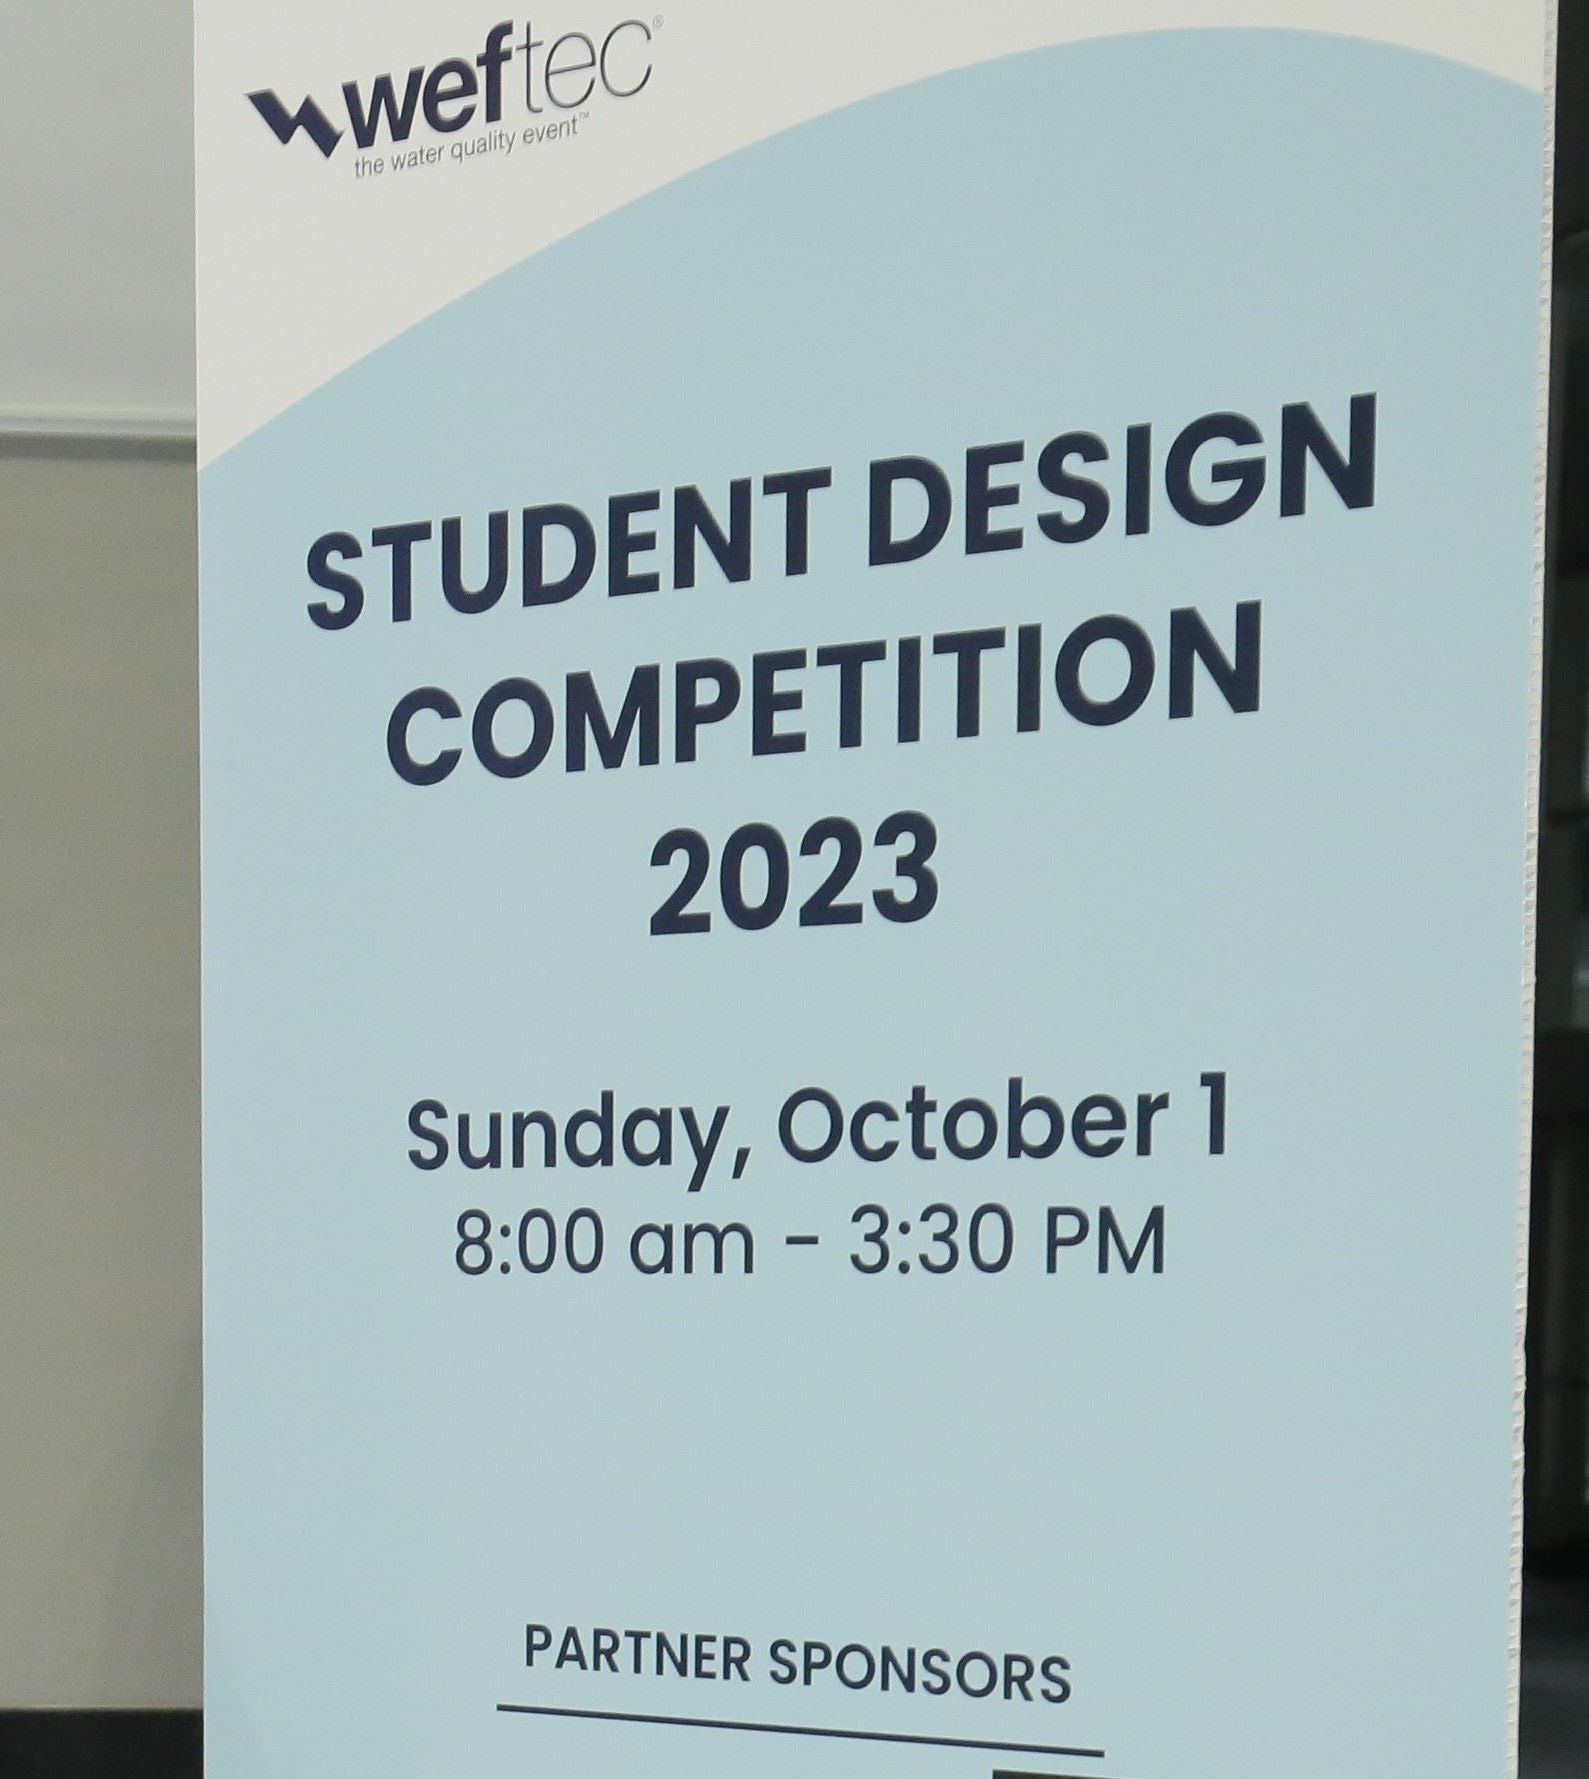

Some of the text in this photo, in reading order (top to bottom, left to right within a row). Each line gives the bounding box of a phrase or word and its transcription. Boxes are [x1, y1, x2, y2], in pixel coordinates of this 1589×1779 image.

[355, 156, 385, 178] the
[390, 145, 445, 172] water
[451, 130, 516, 162] quality
[306, 391, 1378, 632] STUDENT DESIGN
[386, 600, 1263, 788] COMPETITION
[649, 810, 940, 936] 2023
[407, 1071, 1227, 1193] Sunday, October 1
[454, 1206, 605, 1276] 8:00
[629, 1219, 755, 1275] am
[849, 1201, 1015, 1275] 3:30
[1045, 1204, 1166, 1275] PM
[524, 1623, 1072, 1704] PARTNER SPONSORS
